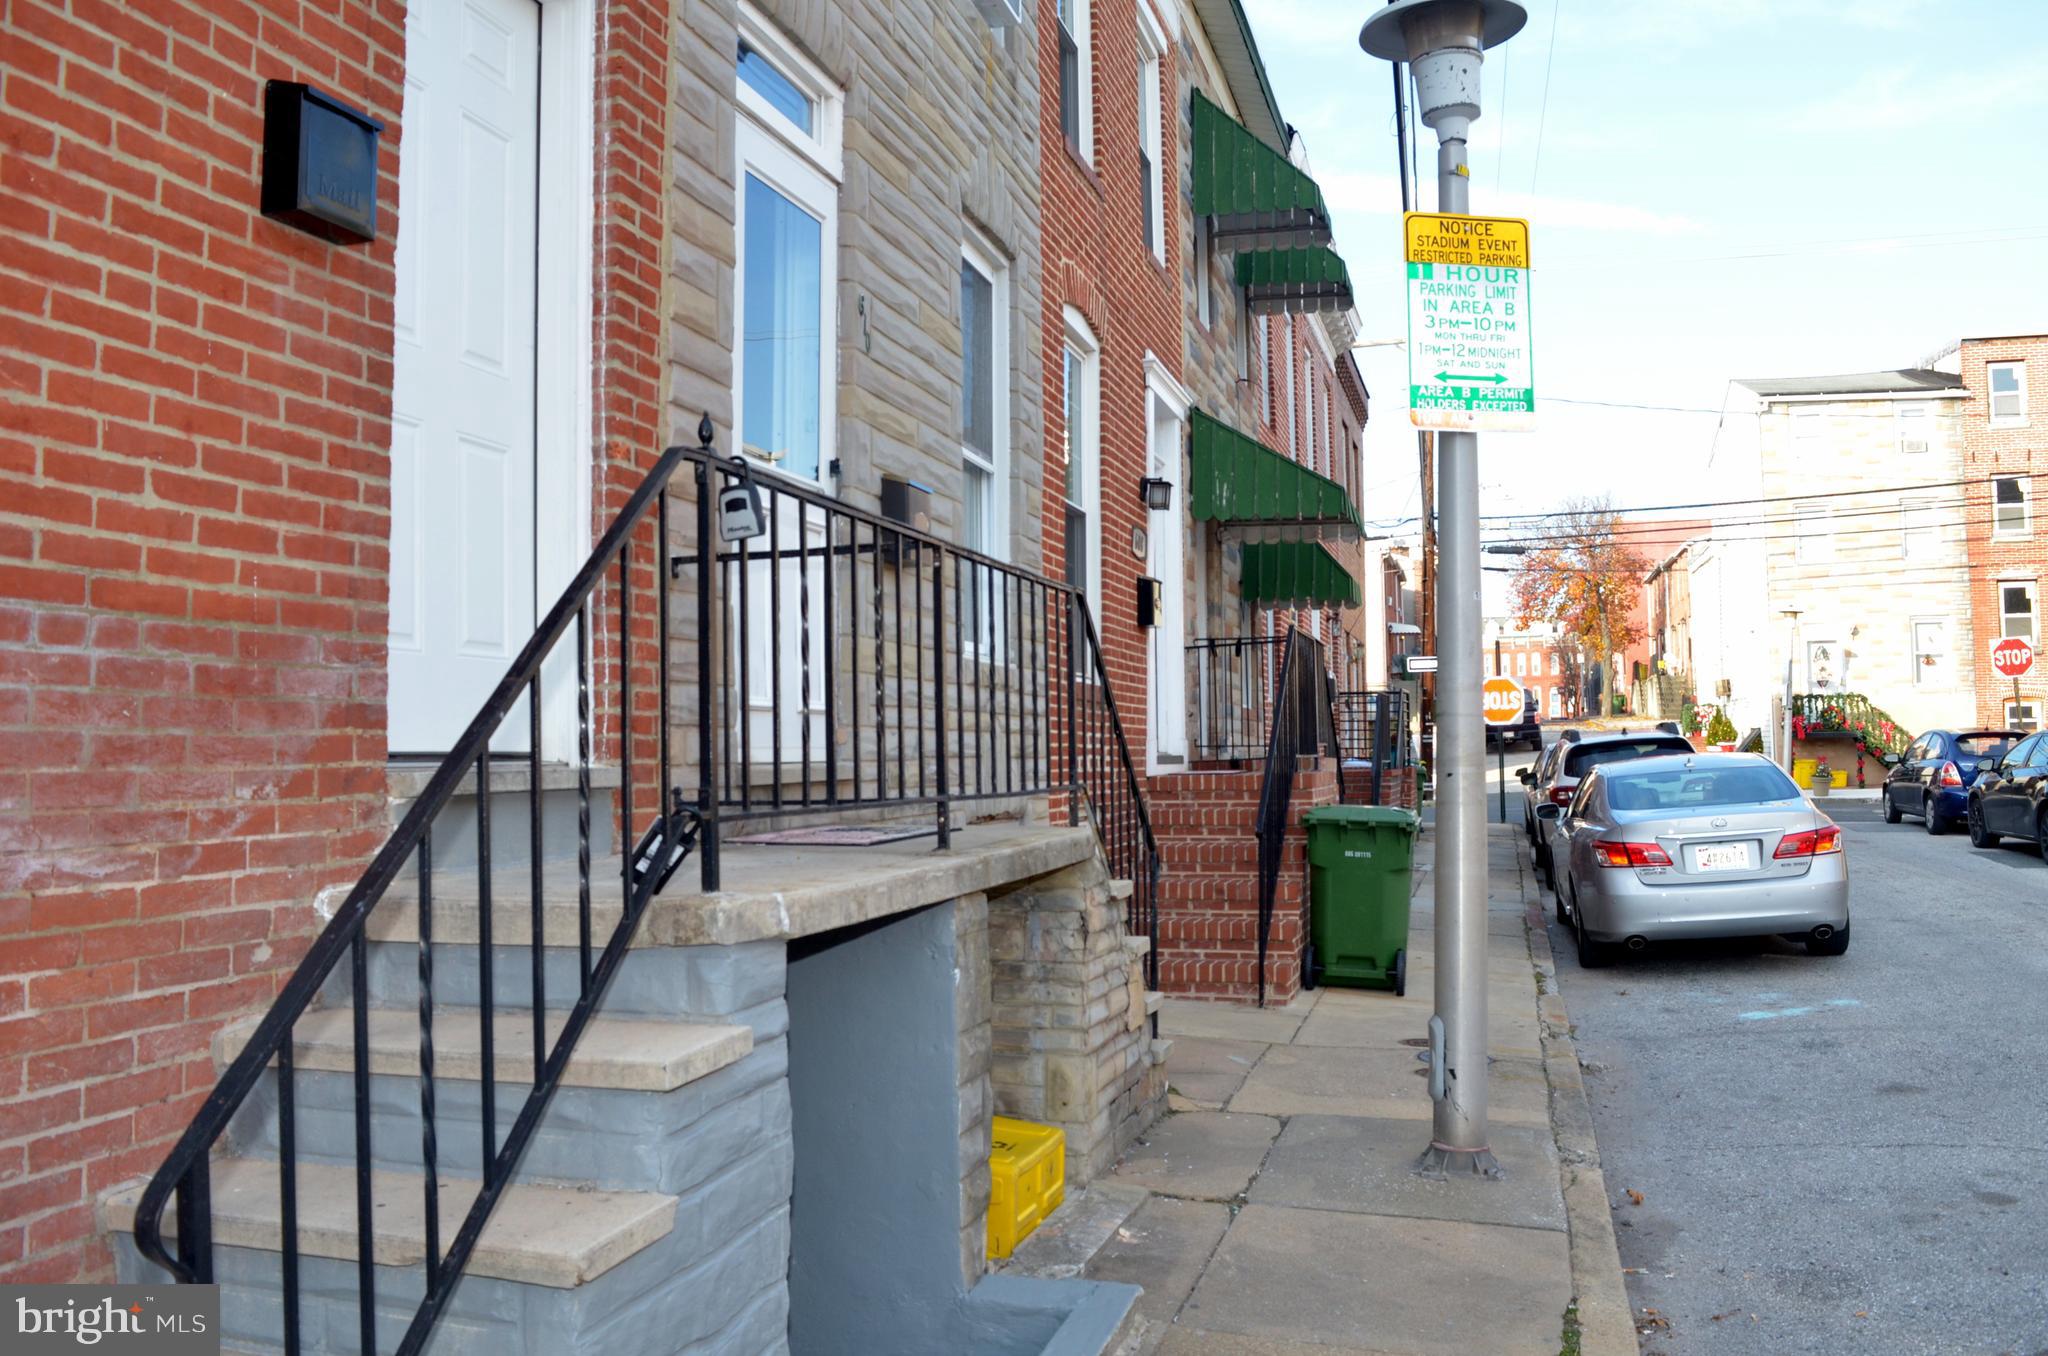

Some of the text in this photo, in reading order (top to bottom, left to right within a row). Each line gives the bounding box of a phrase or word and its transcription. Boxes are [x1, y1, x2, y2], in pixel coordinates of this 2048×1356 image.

[1439, 220, 1494, 236] NOTICE
[1417, 235, 1518, 252] STADIUM EVENT
[1413, 249, 1522, 266] RESTRICTED PARKING
[1446, 265, 1519, 283] HOUR
[1420, 282, 1517, 299] PARKING LIMIT
[1423, 299, 1515, 316] IN AREA B
[1435, 332, 1506, 342] MON THRU FRI
[1468, 347, 1521, 359] MIDNIGHT
[1437, 359, 1455, 367] SAT
[1485, 361, 1506, 369] SUN
[1418, 386, 1526, 399] AREA B PERMIT
[1417, 399, 1527, 411] HOLDERS EXCEPTED
[1994, 648, 2031, 667] STOP
